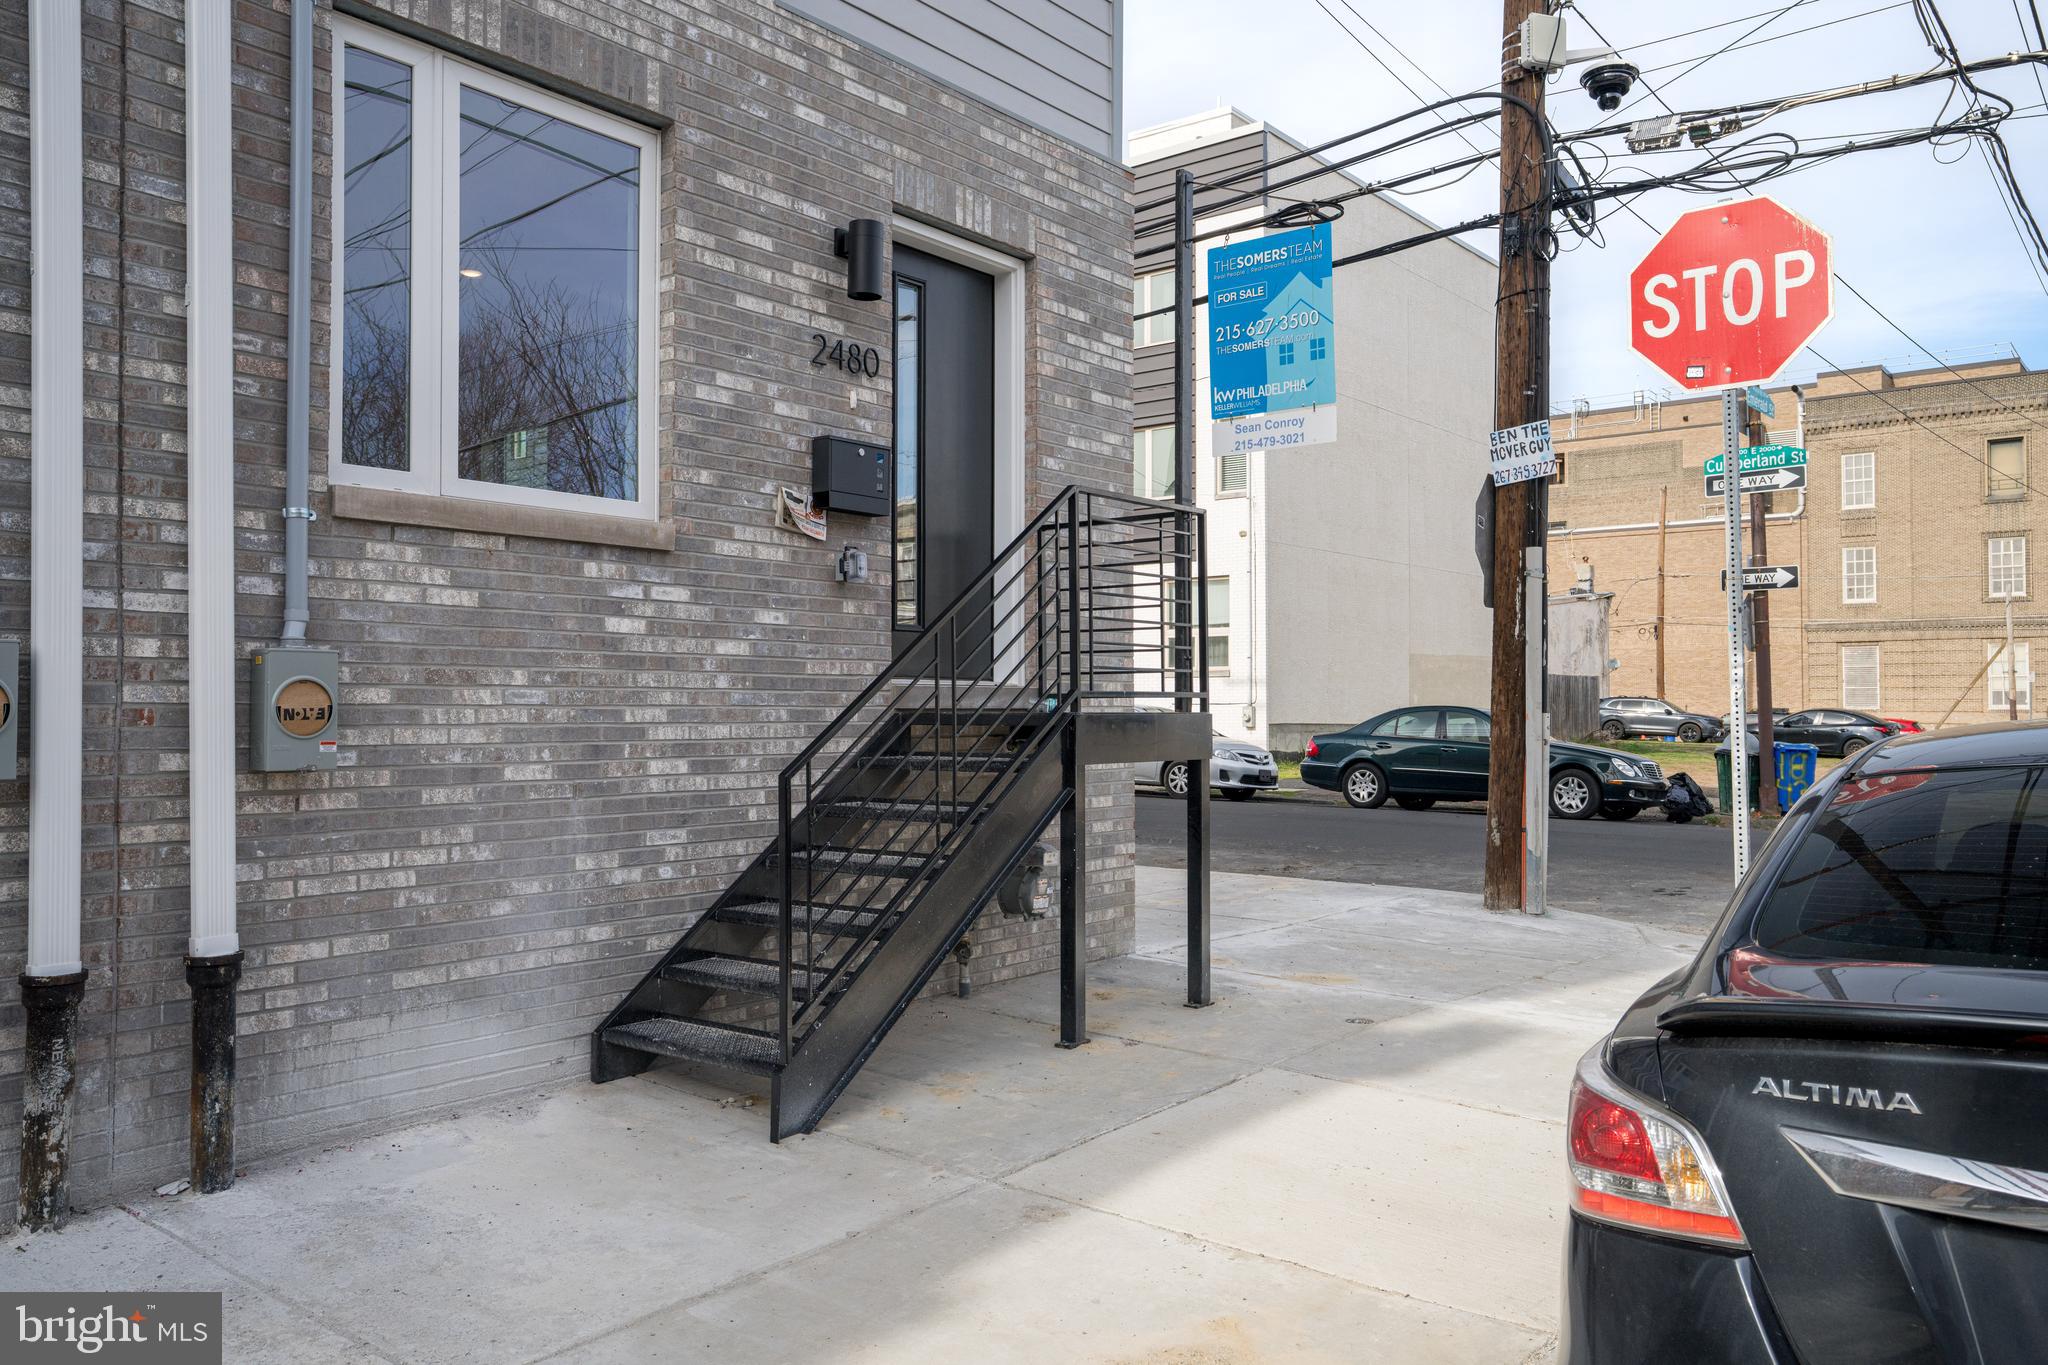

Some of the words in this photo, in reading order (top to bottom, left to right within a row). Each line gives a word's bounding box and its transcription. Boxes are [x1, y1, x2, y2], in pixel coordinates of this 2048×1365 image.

[1217, 291, 1237, 304] FOR
[1239, 285, 1265, 300] SALE
[1642, 249, 1816, 339] STOP
[811, 333, 881, 378] 2480
[1236, 378, 1308, 401] PHILADELPHIA
[1235, 423, 1262, 434] Sean
[1264, 416, 1305, 431] Conroy
[1490, 429, 1518, 447] BEN
[1521, 421, 1549, 439] THE
[1235, 432, 1305, 451] 215-479-3021
[1490, 441, 1529, 462] MOVER
[1529, 437, 1551, 455] GUY
[1706, 452, 1785, 473] Cuerland
[1791, 451, 1804, 463] St
[1748, 475, 1775, 486] WAY
[1754, 574, 1776, 584] WAY
[1751, 1076, 1924, 1115] ALTIMA
